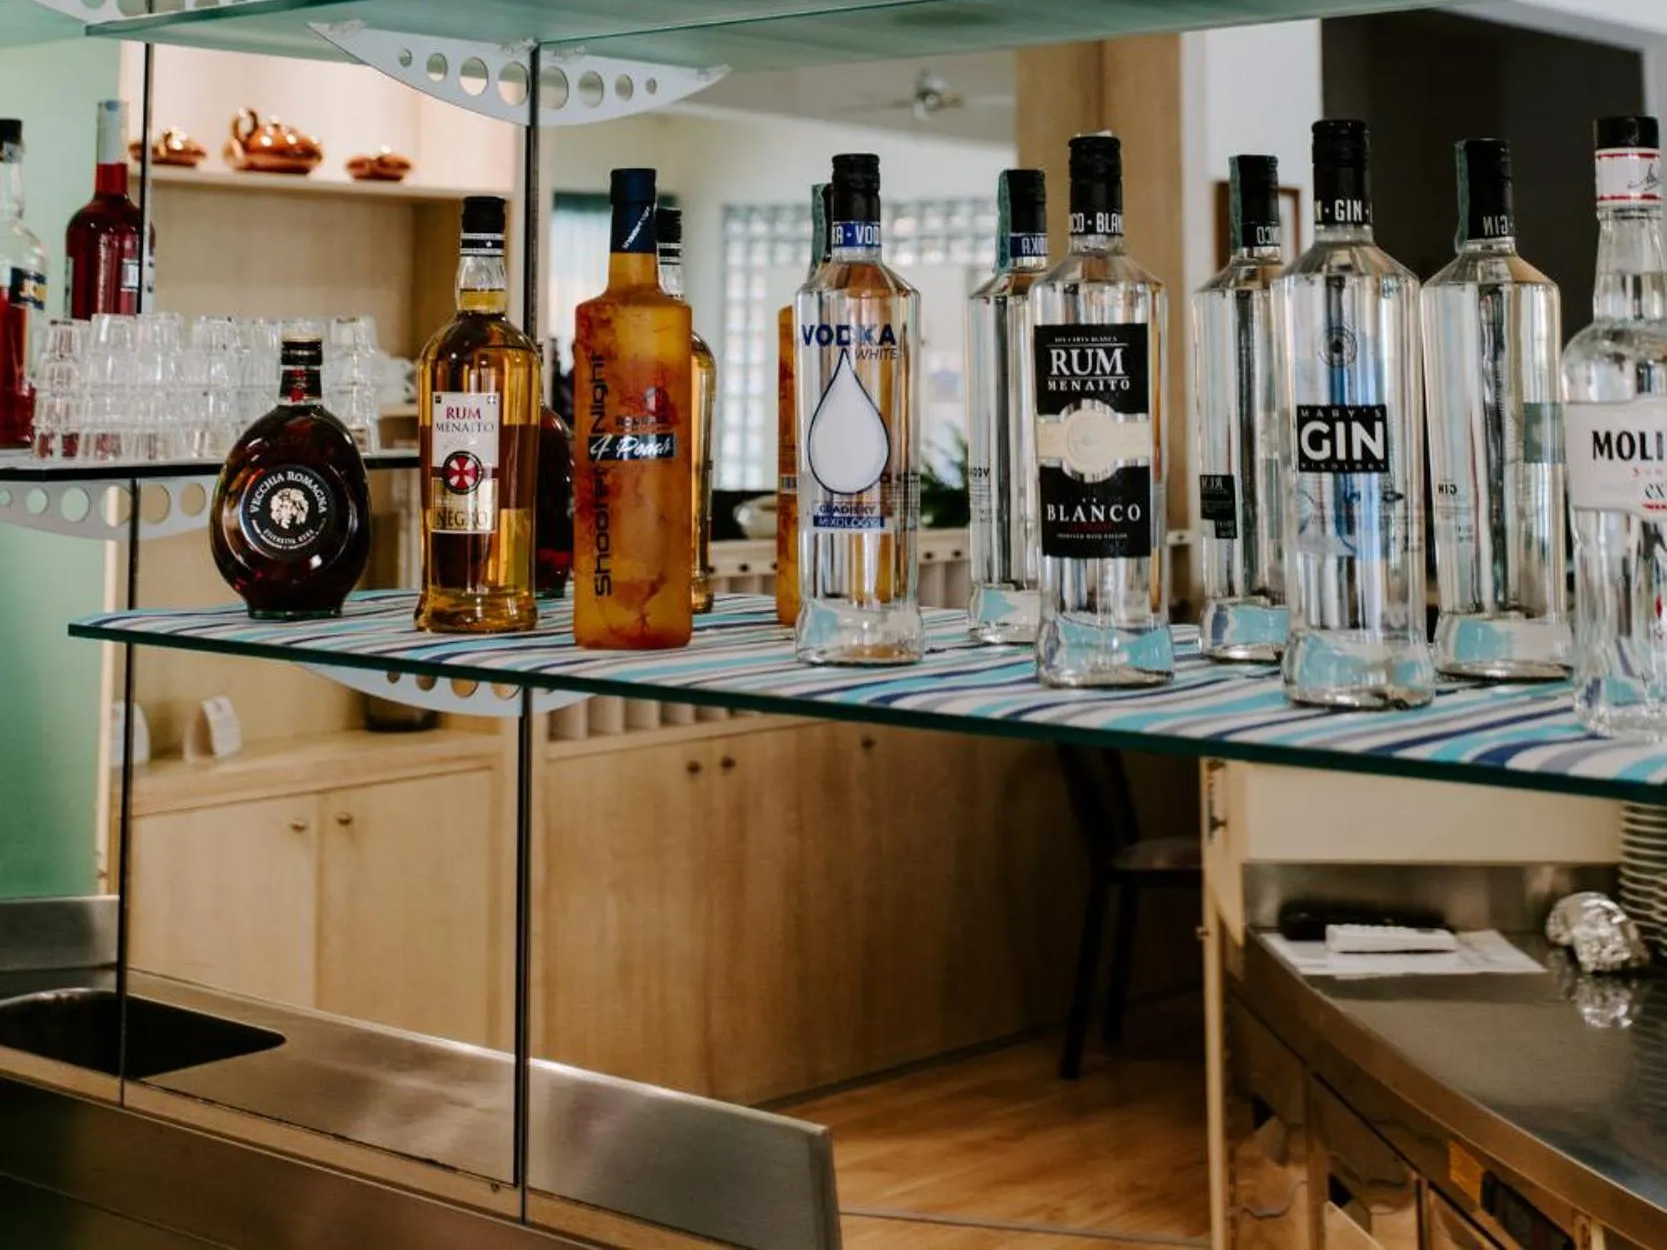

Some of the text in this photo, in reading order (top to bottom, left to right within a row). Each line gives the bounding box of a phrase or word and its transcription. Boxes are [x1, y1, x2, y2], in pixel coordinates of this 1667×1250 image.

[1334, 198, 1363, 222] GIN
[801, 323, 896, 347] VODKA
[856, 348, 898, 360] WHITE
[1050, 347, 1125, 376] RUM
[1047, 379, 1131, 391] MENAITO
[446, 406, 482, 420] RUM
[1301, 408, 1382, 418] MARY'S
[1300, 419, 1385, 461] GIN
[250, 471, 328, 514] VECCHIA ROMAGNA
[1046, 502, 1141, 523] BLANCO
